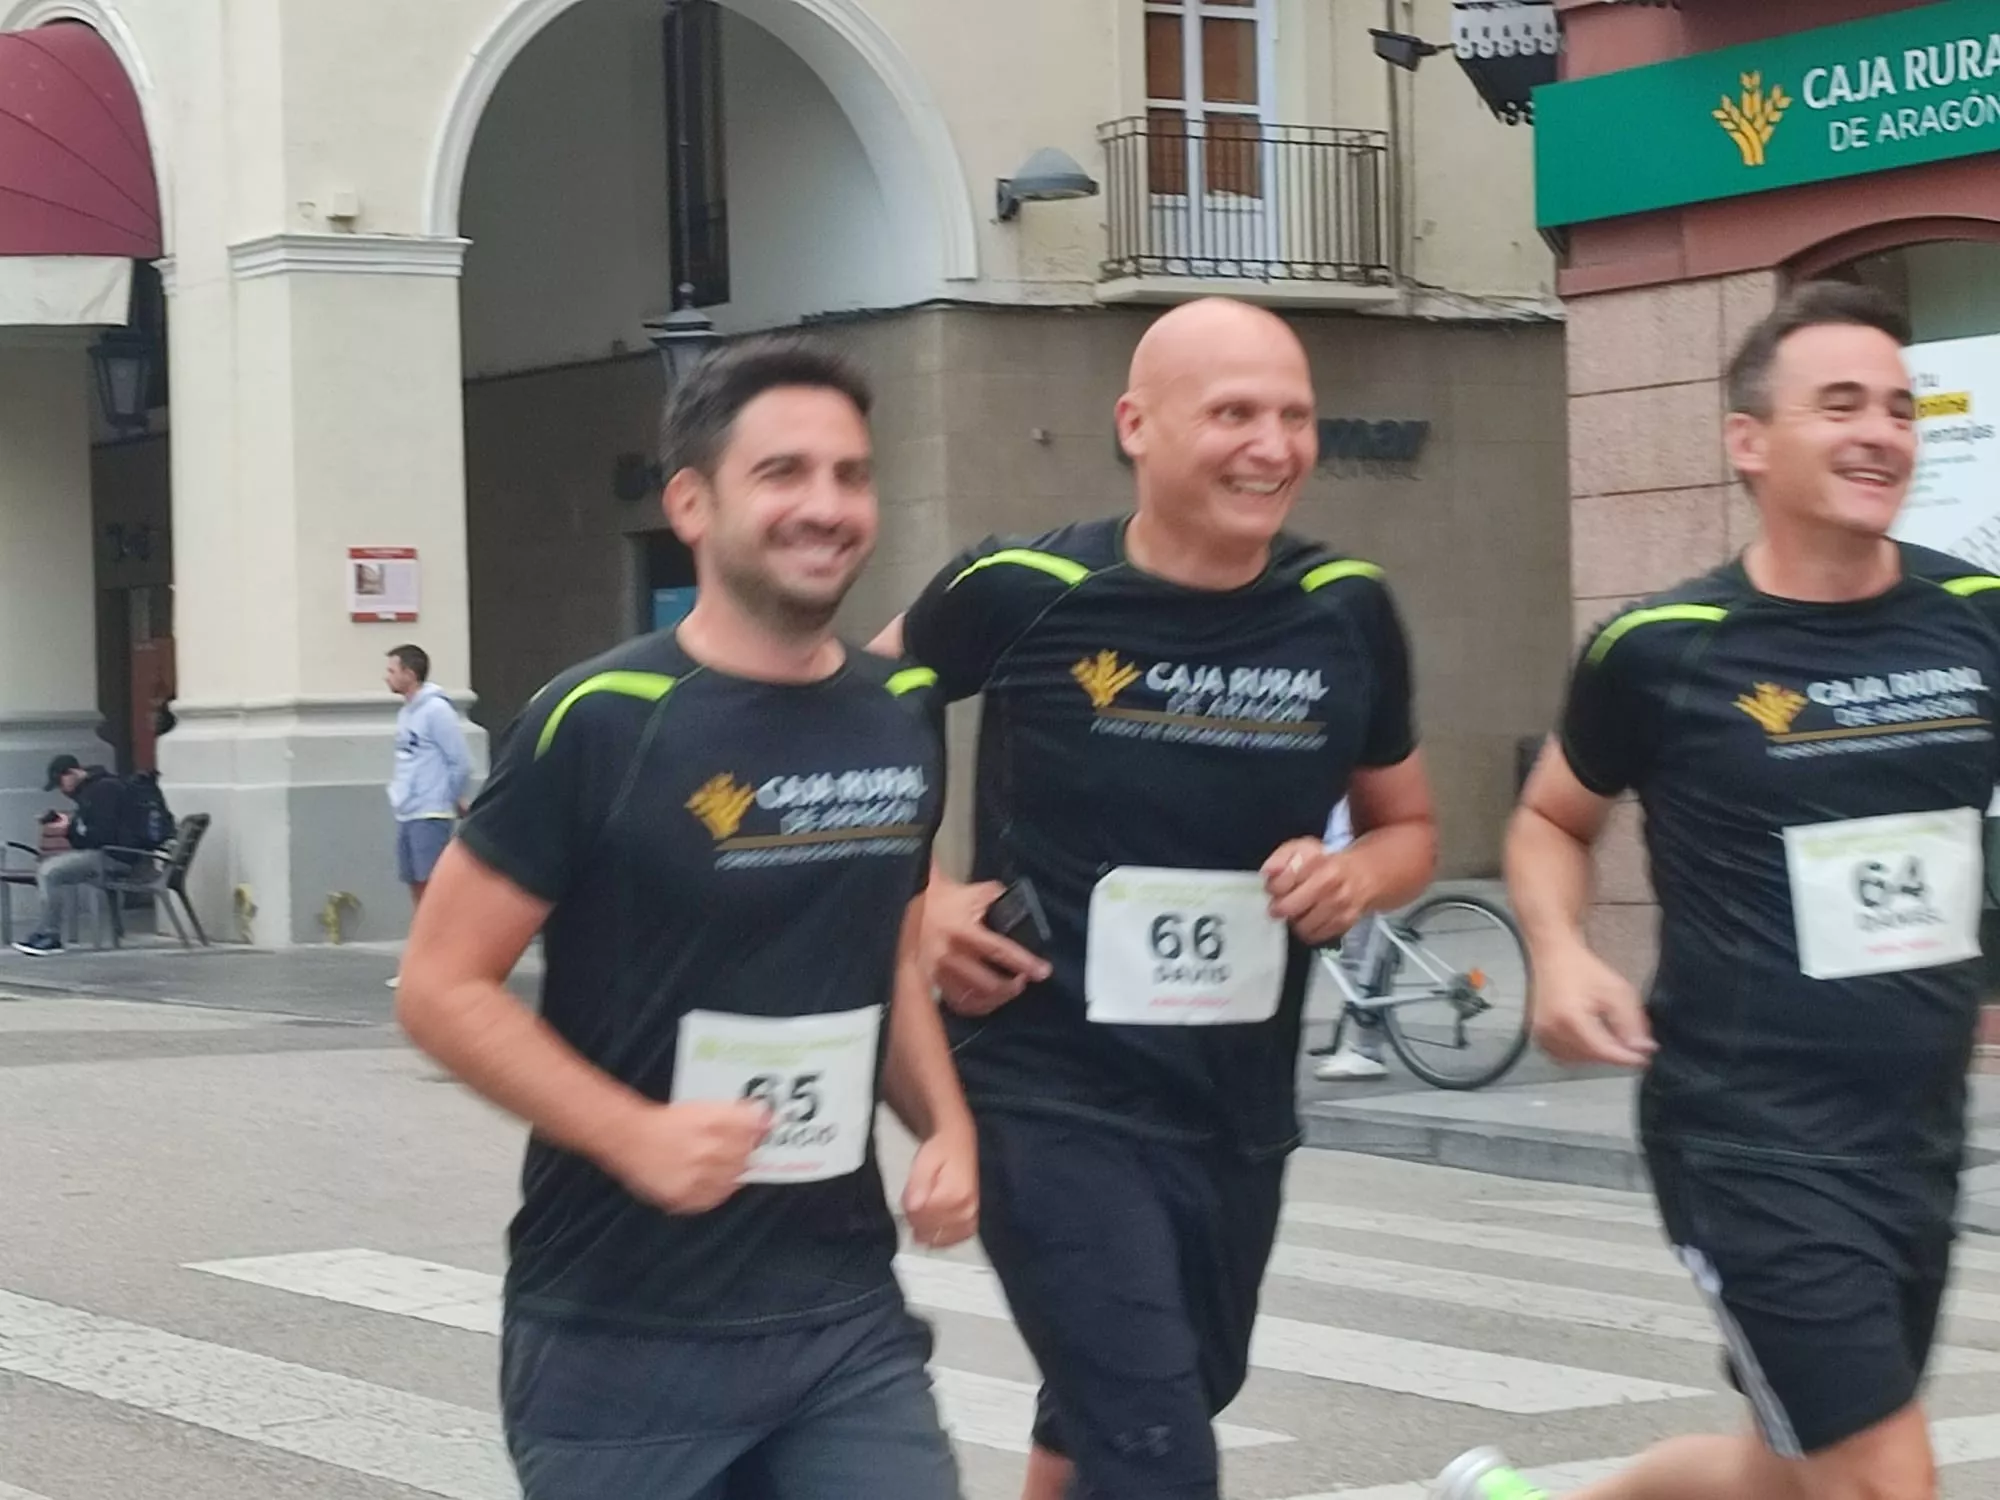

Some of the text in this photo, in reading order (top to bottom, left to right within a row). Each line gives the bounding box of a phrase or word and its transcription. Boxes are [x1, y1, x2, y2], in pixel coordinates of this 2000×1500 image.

[1802, 55, 1897, 109] CAJA
[1829, 87, 2000, 152] DE ARAGÓN
[1853, 855, 1930, 908] 64
[1150, 913, 1227, 960] 66
[738, 1069, 824, 1123] 65
